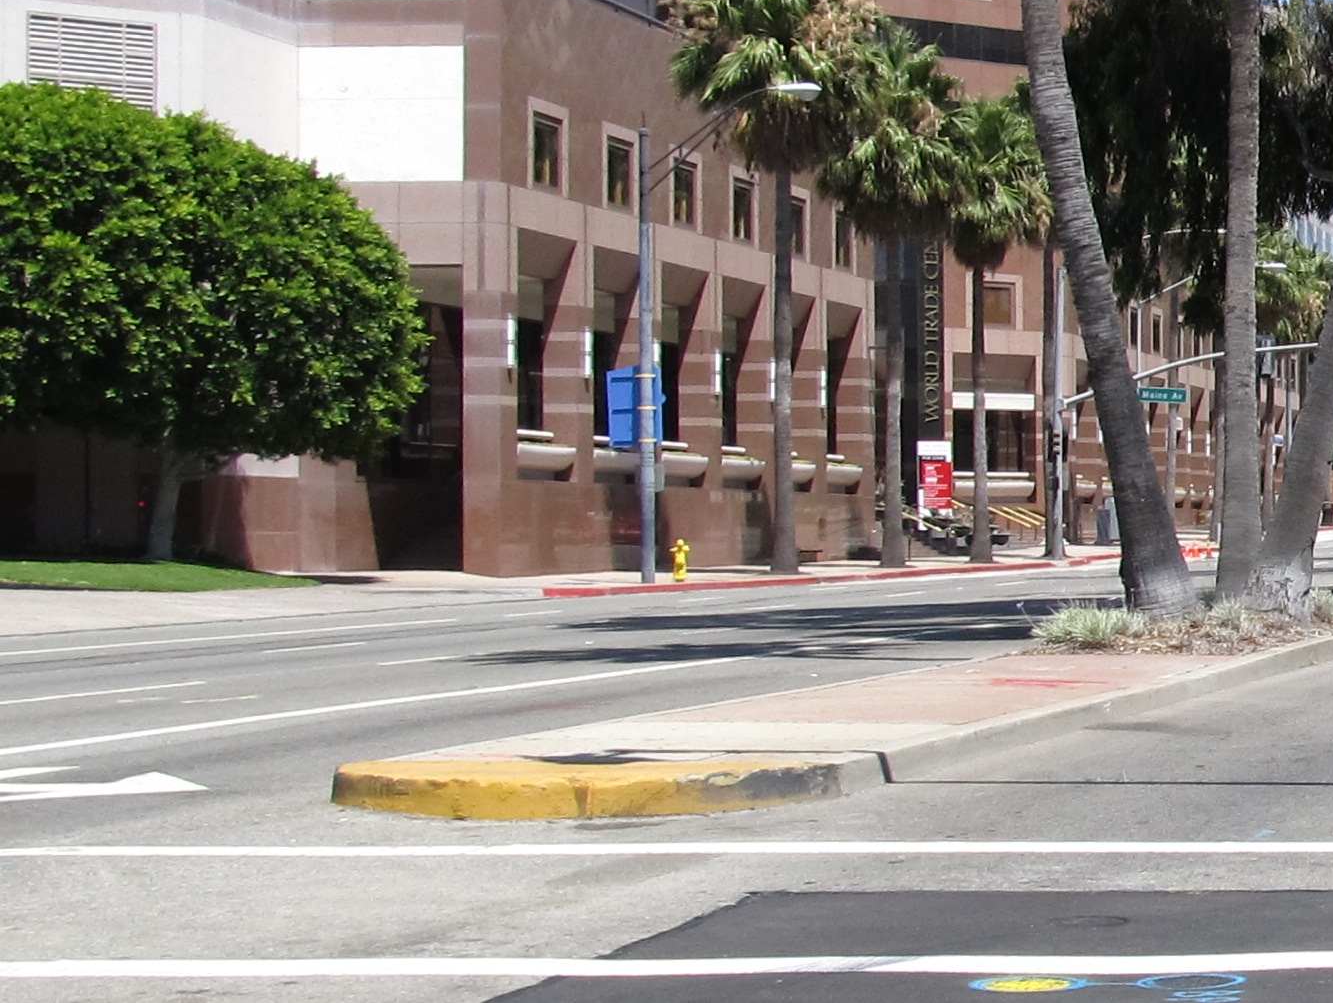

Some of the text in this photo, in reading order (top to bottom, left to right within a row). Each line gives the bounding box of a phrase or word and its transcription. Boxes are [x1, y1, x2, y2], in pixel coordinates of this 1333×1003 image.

[924, 284, 940, 345] TRADE
[924, 350, 940, 423] WORLD
[1142, 391, 1168, 399] Maine
